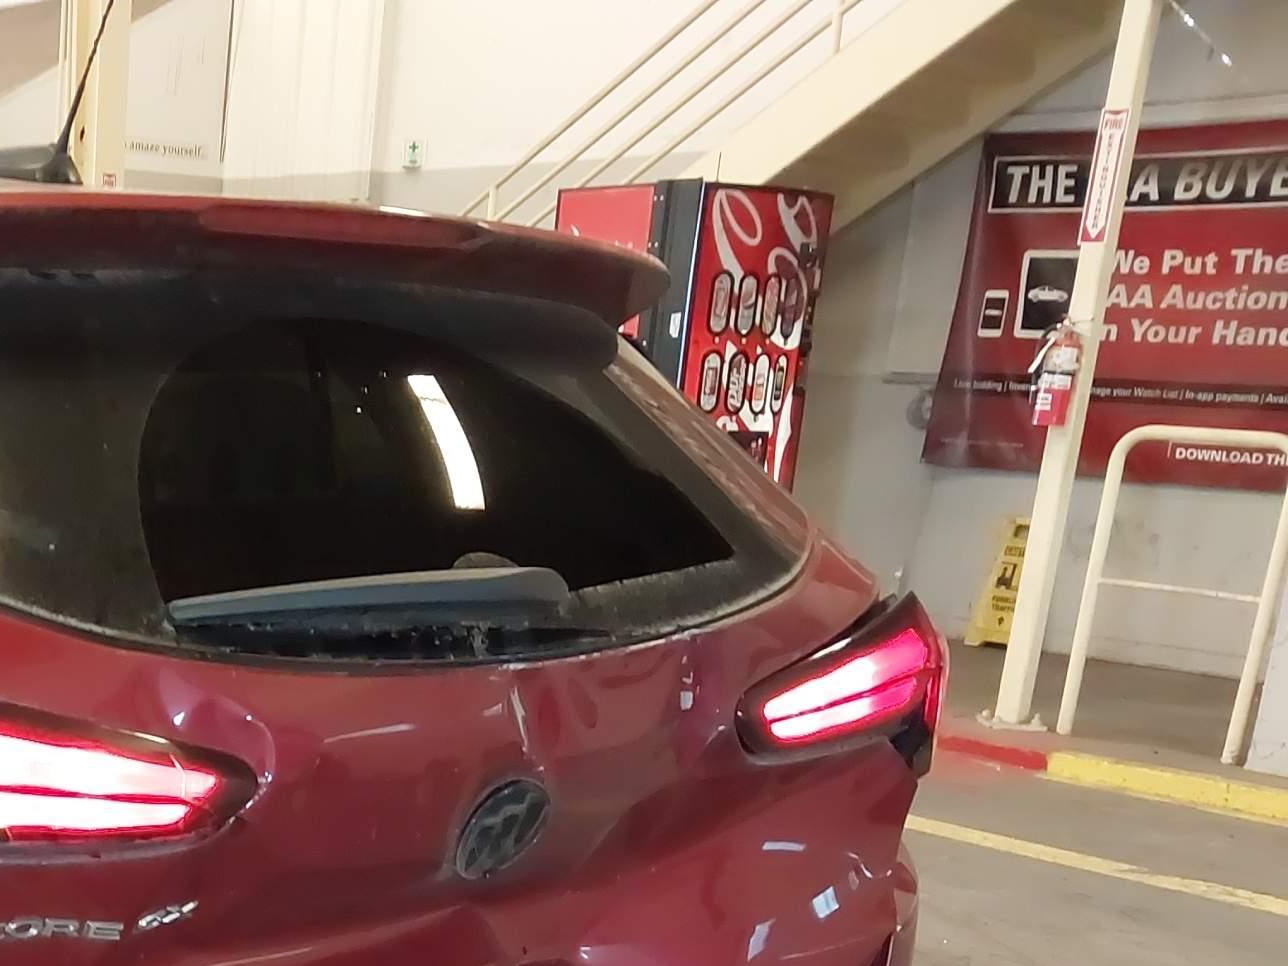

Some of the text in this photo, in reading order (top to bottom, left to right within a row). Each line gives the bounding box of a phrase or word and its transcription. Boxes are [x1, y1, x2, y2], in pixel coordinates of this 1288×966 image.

[1104, 118, 1123, 129] FIRE
[129, 140, 160, 152] amaze
[1007, 164, 1078, 204] THE
[1162, 249, 1218, 275] Put
[1105, 283, 1288, 310] AA Auction
[1131, 318, 1202, 344] Your
[1175, 447, 1288, 466] DOWNLOAD TH
